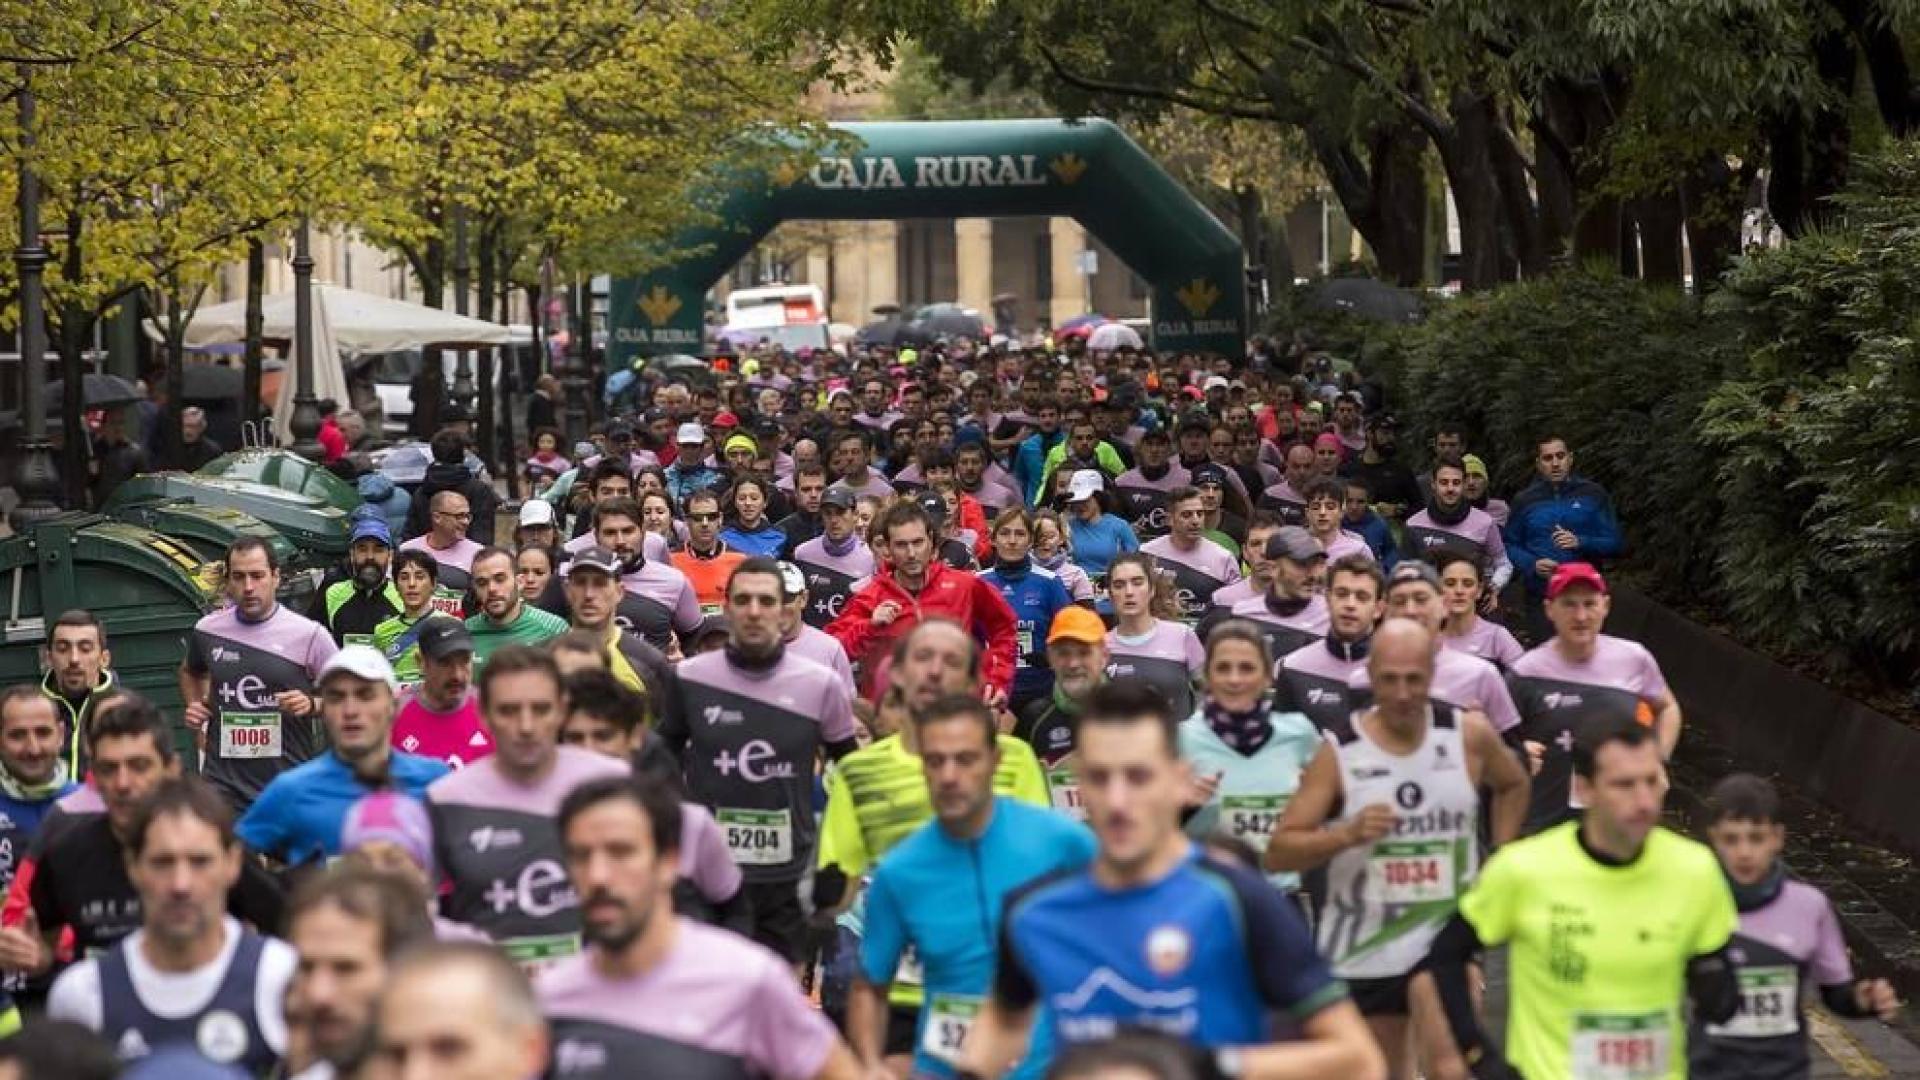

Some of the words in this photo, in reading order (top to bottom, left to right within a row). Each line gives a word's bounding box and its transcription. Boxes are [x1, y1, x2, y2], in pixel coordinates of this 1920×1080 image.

[809, 156, 905, 190] CAJA
[914, 154, 1047, 187] RURAL
[653, 327, 699, 343] RURAL
[231, 728, 271, 746] 1008
[728, 827, 779, 849] 5204
[1384, 860, 1438, 885] 1034
